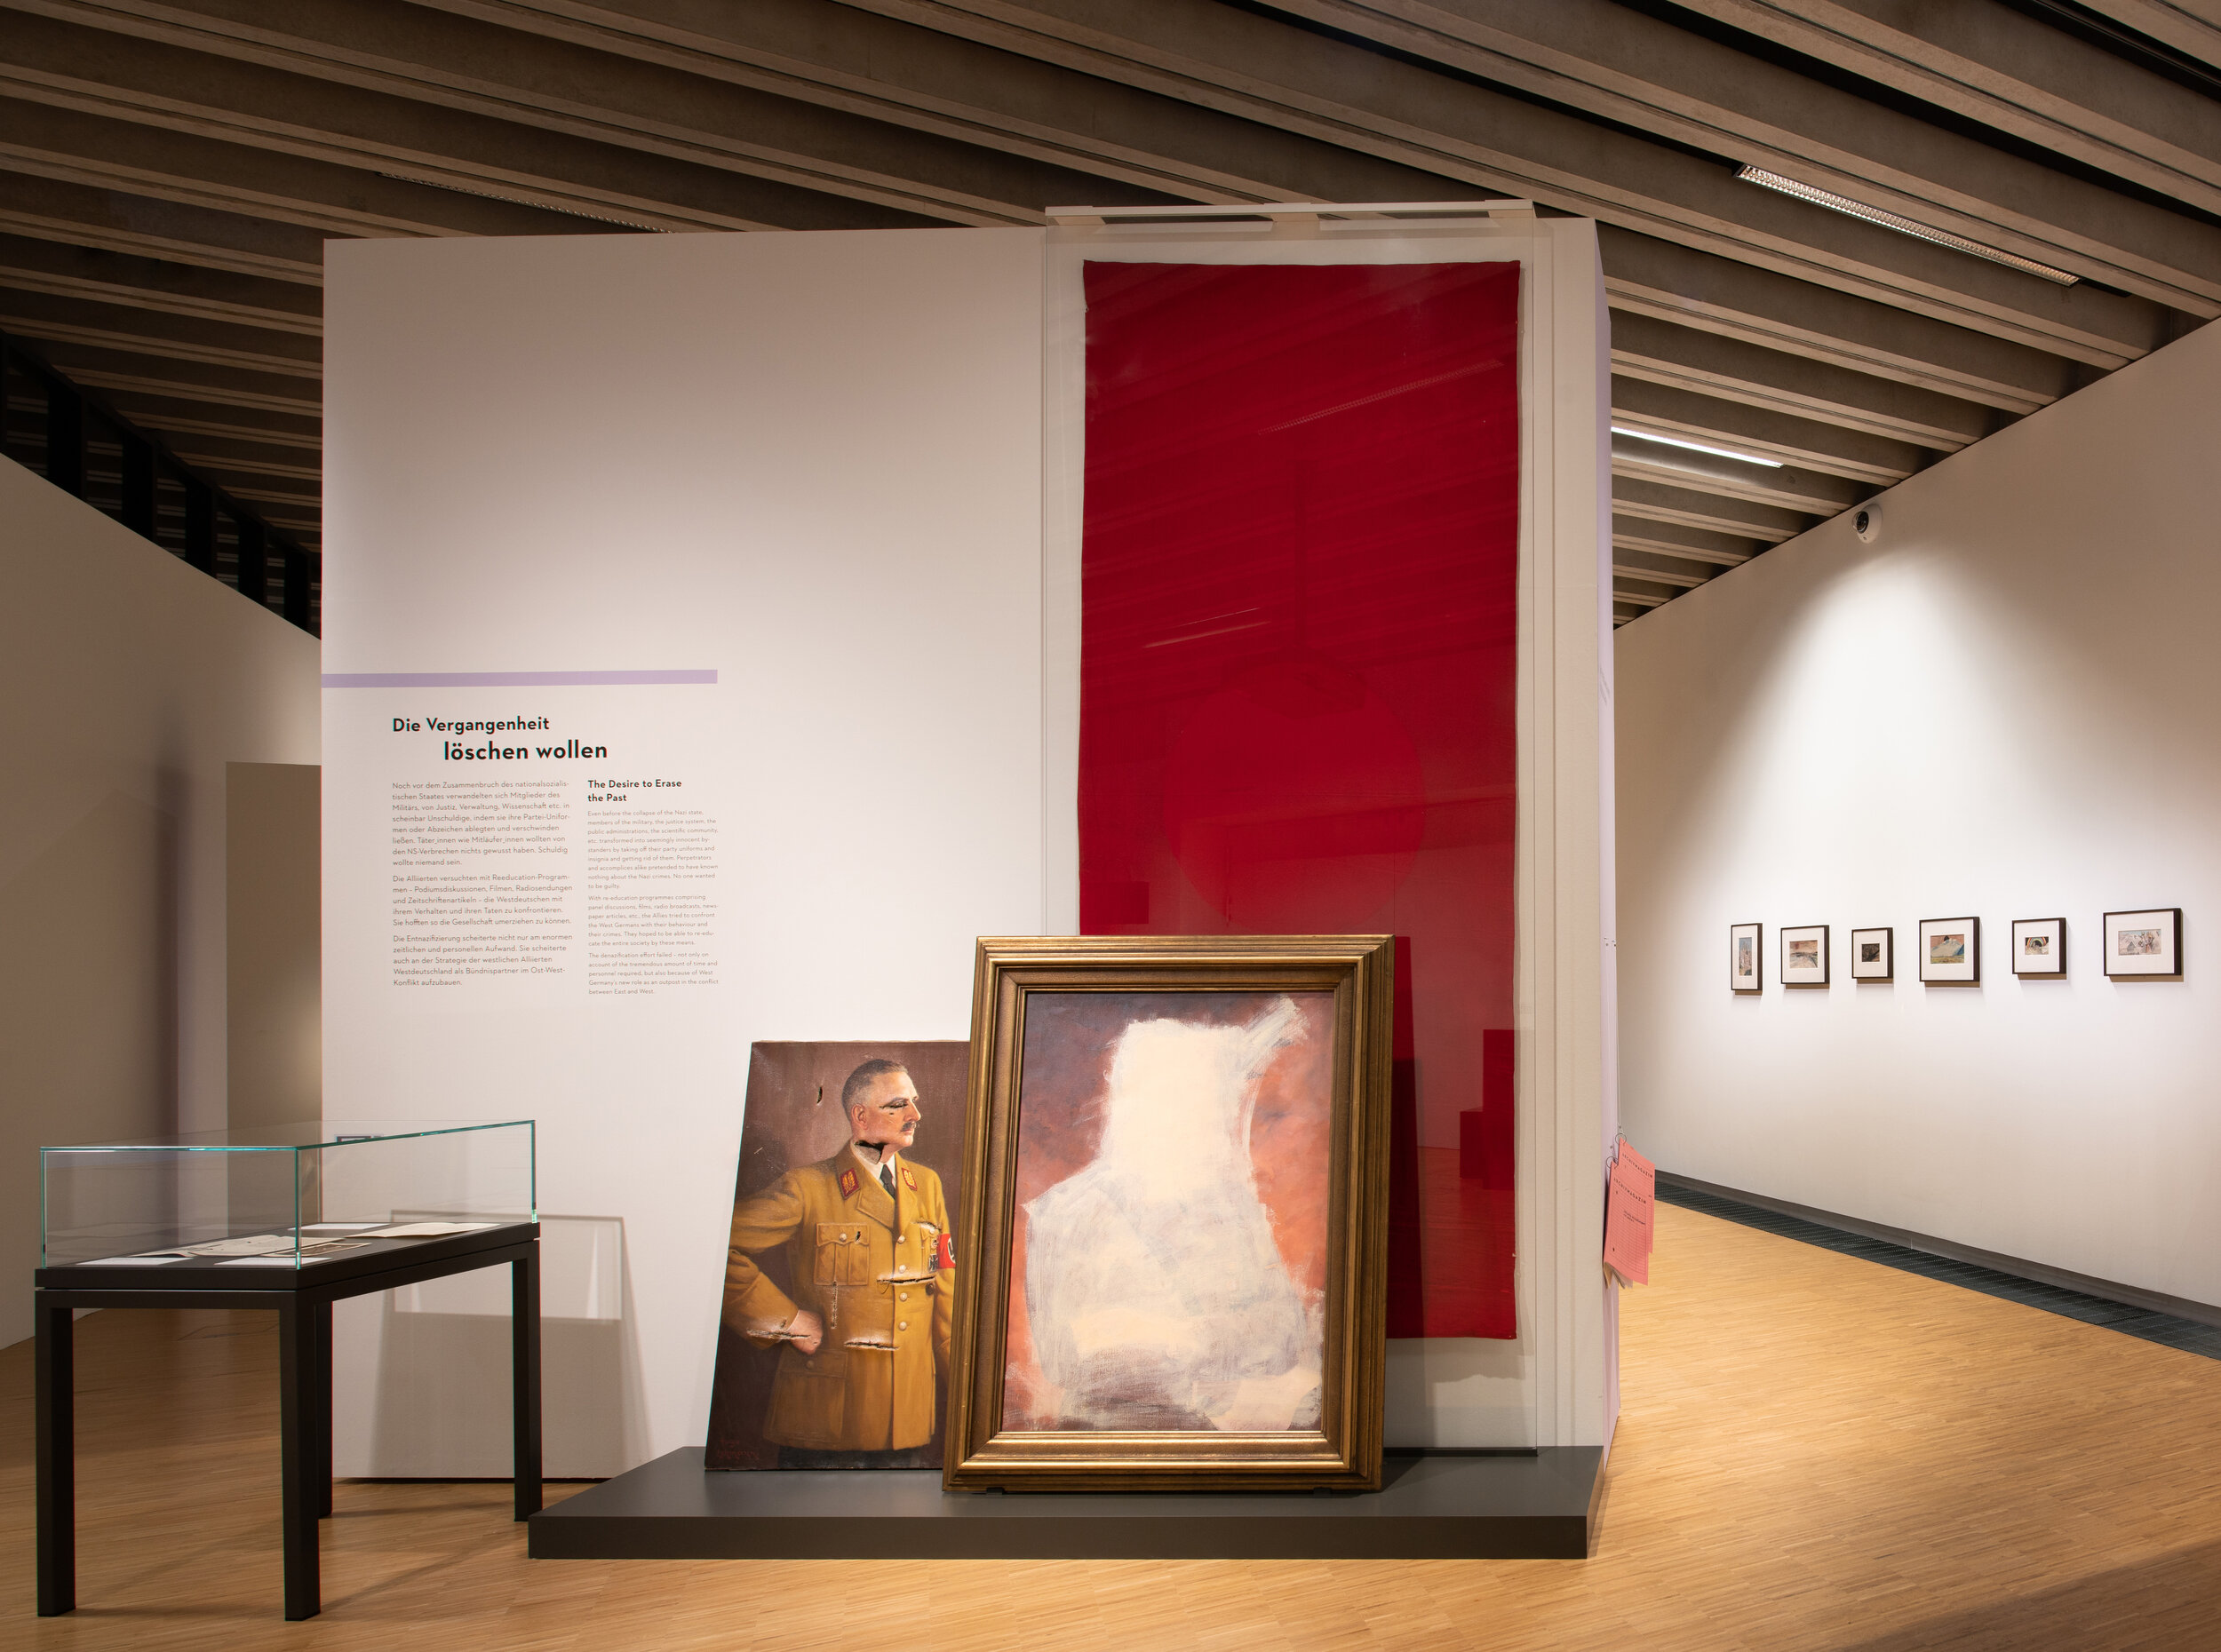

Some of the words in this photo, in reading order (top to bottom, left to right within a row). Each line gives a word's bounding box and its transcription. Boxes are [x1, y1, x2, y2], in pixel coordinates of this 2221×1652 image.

[393, 718, 421, 733] Die
[426, 715, 550, 735] Vergangenheit
[444, 740, 529, 761] löschen
[535, 739, 608, 759] wollen
[587, 779, 606, 789] The
[609, 779, 641, 789] Desire
[655, 778, 682, 788] Erase
[510, 791, 545, 800] Mitglieder
[587, 793, 604, 802] the
[606, 793, 627, 802] Past
[465, 825, 495, 834] ablegten
[537, 846, 568, 855] Schuldig
[435, 957, 466, 965] Strategie
